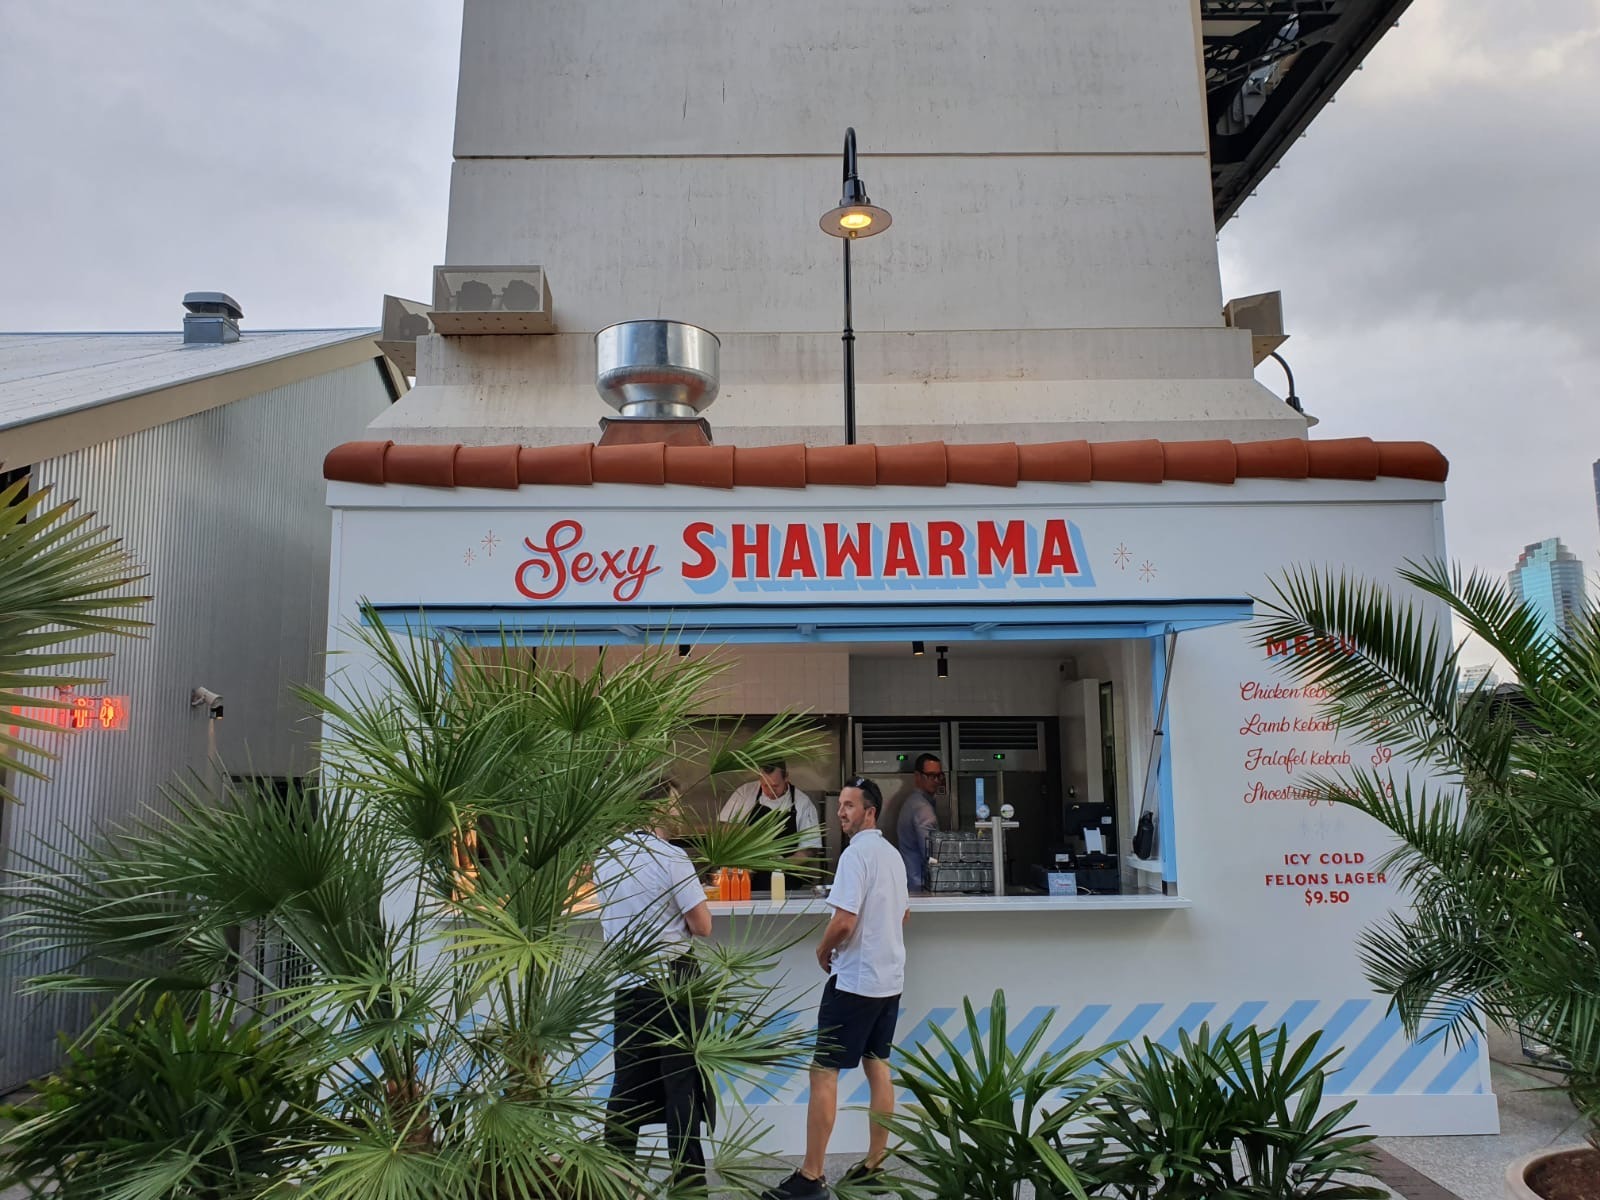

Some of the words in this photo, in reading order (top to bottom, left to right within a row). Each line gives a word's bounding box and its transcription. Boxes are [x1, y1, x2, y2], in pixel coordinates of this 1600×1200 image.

[513, 519, 662, 601] Sexy
[681, 519, 1090, 589] SHAWARMA
[1240, 681, 1300, 701] Chicken
[1239, 713, 1290, 735] Lamb
[1244, 748, 1308, 774] Falafel
[1371, 743, 1392, 767] $9
[1284, 853, 1312, 866] ICY
[1319, 852, 1365, 865] COLD
[1265, 873, 1329, 886] FELONS
[1335, 872, 1387, 884] LAGER
[1304, 888, 1350, 907] $9.50
